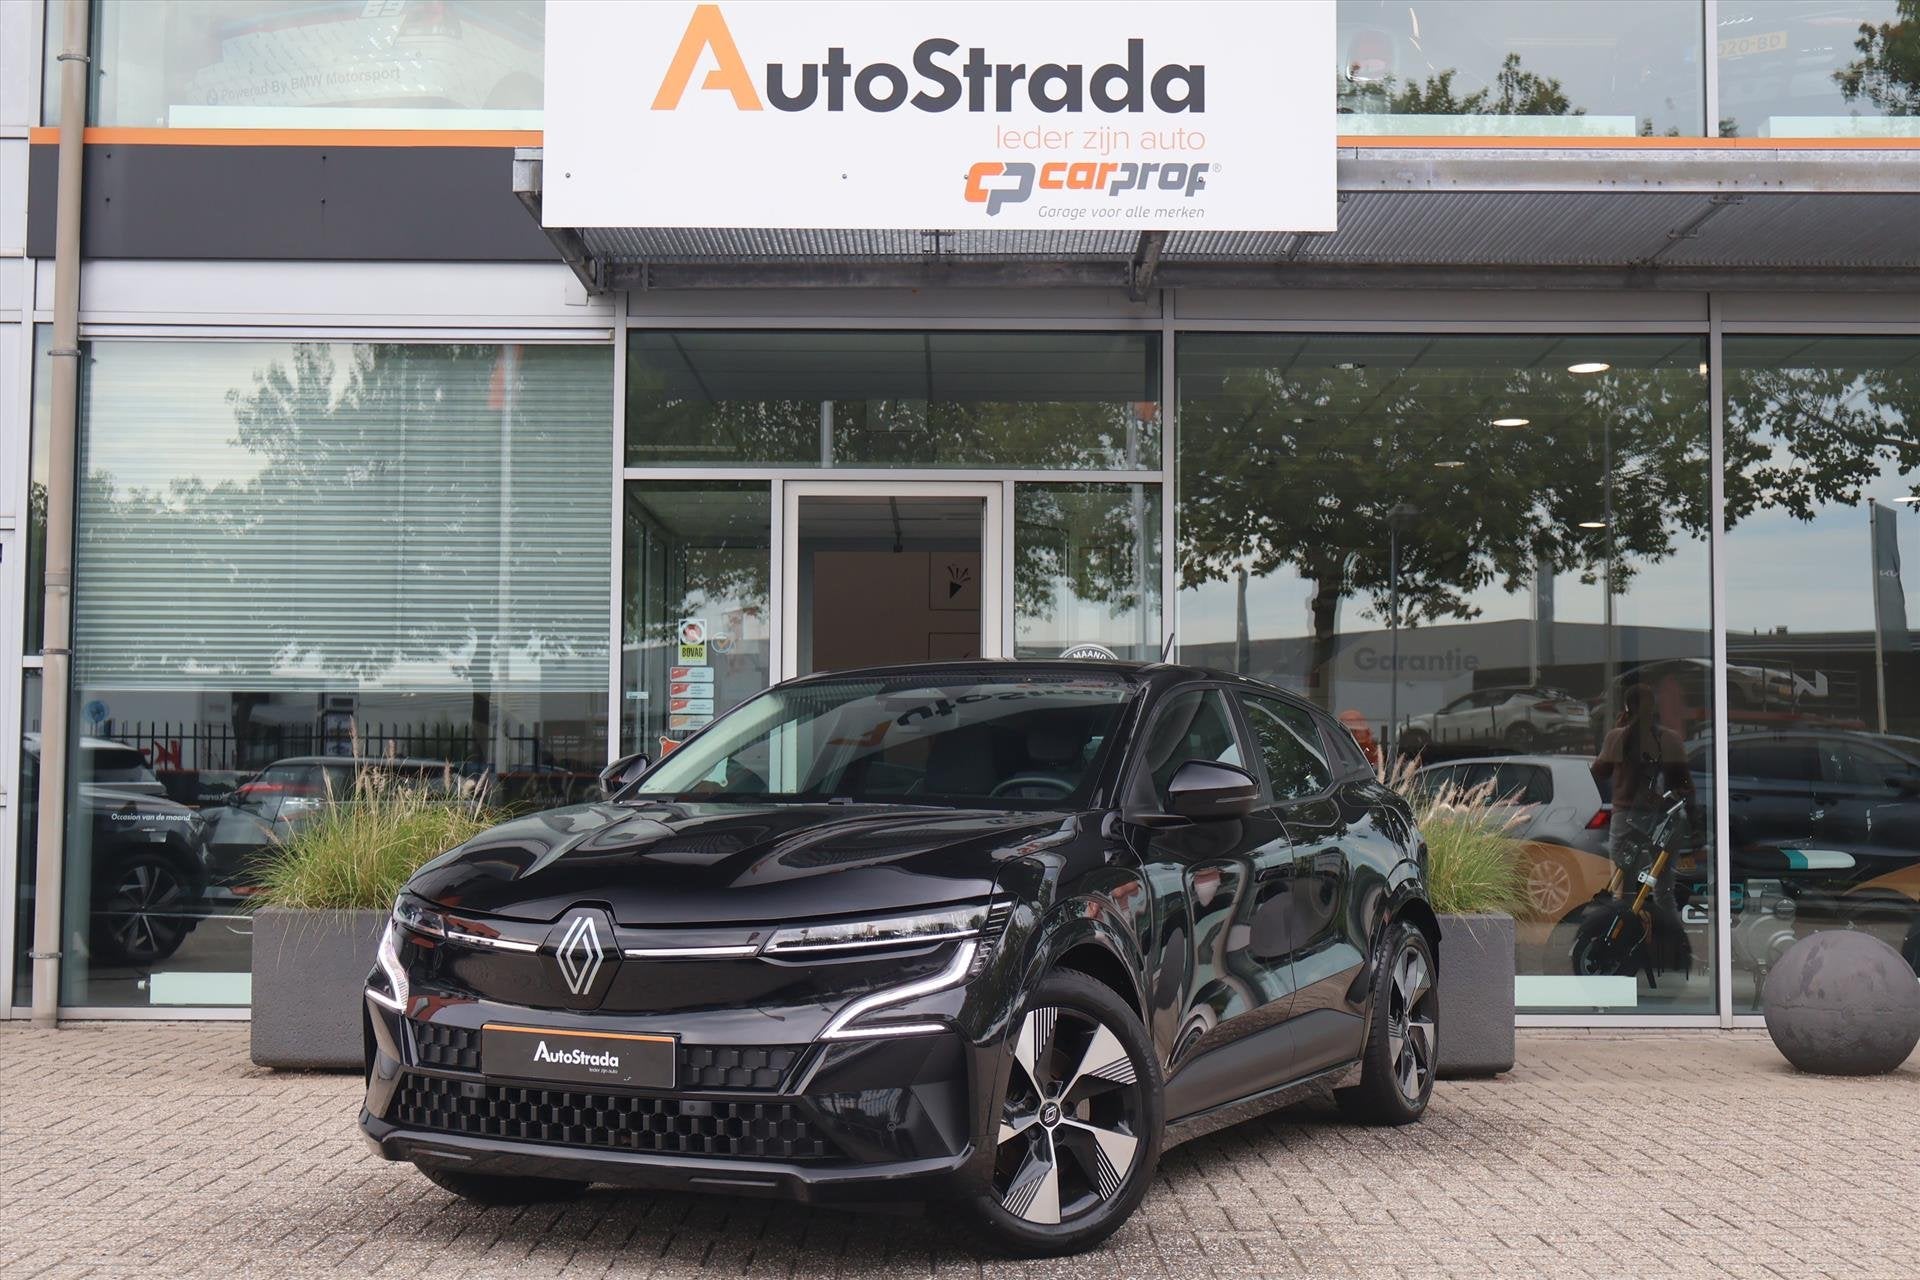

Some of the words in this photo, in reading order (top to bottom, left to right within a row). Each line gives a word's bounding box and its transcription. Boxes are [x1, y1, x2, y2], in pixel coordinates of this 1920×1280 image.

[650, 4, 1205, 114] AutoStrada
[272, 79, 288, 95] By
[290, 74, 322, 91] BMW
[326, 67, 400, 86] Motorsport
[996, 124, 1074, 149] Ieder
[1083, 125, 1129, 156] zijn
[1140, 128, 1205, 150] auto
[1039, 162, 1210, 197] carprof
[1038, 205, 1087, 220] Garage
[1092, 208, 1122, 218] voor
[1126, 206, 1150, 218] alle
[1155, 206, 1205, 218] merken
[682, 647, 703, 658] BOVAG
[1354, 646, 1478, 672] Garantie
[111, 813, 141, 822] Occasion
[156, 814, 165, 822] de
[166, 813, 191, 822] maand
[533, 1040, 619, 1067] AutoStrada
